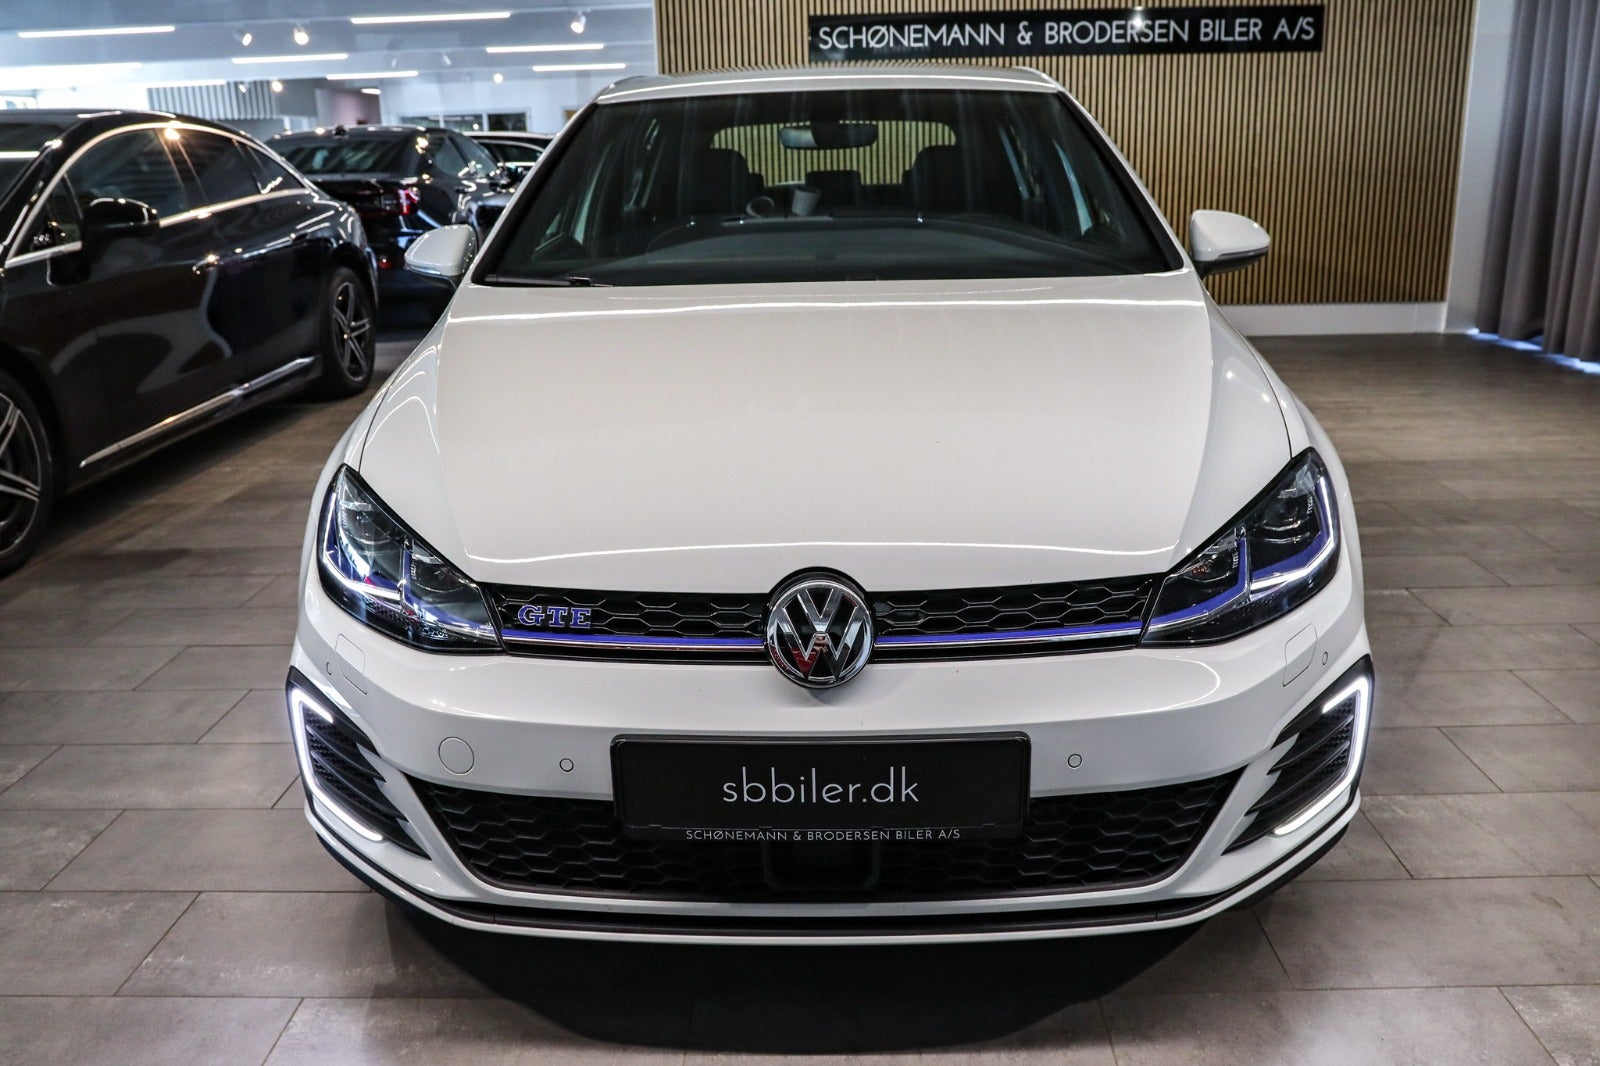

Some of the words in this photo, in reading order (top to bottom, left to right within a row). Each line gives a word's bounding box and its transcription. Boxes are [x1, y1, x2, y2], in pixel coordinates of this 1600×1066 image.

[818, 23, 1006, 50] SCHØNEMANN
[1016, 21, 1033, 46] &
[1044, 19, 1190, 45] BRODERSEN
[1199, 17, 1262, 42] BILER
[1273, 16, 1316, 41] A/S
[517, 604, 592, 630] GTE
[722, 765, 920, 804] sbbiler.dk
[685, 829, 788, 842] SCHØNEMANN
[793, 831, 802, 841] &
[807, 830, 890, 842] BRODERSEN
[895, 829, 933, 841] BILER
[938, 829, 961, 840] A/S
